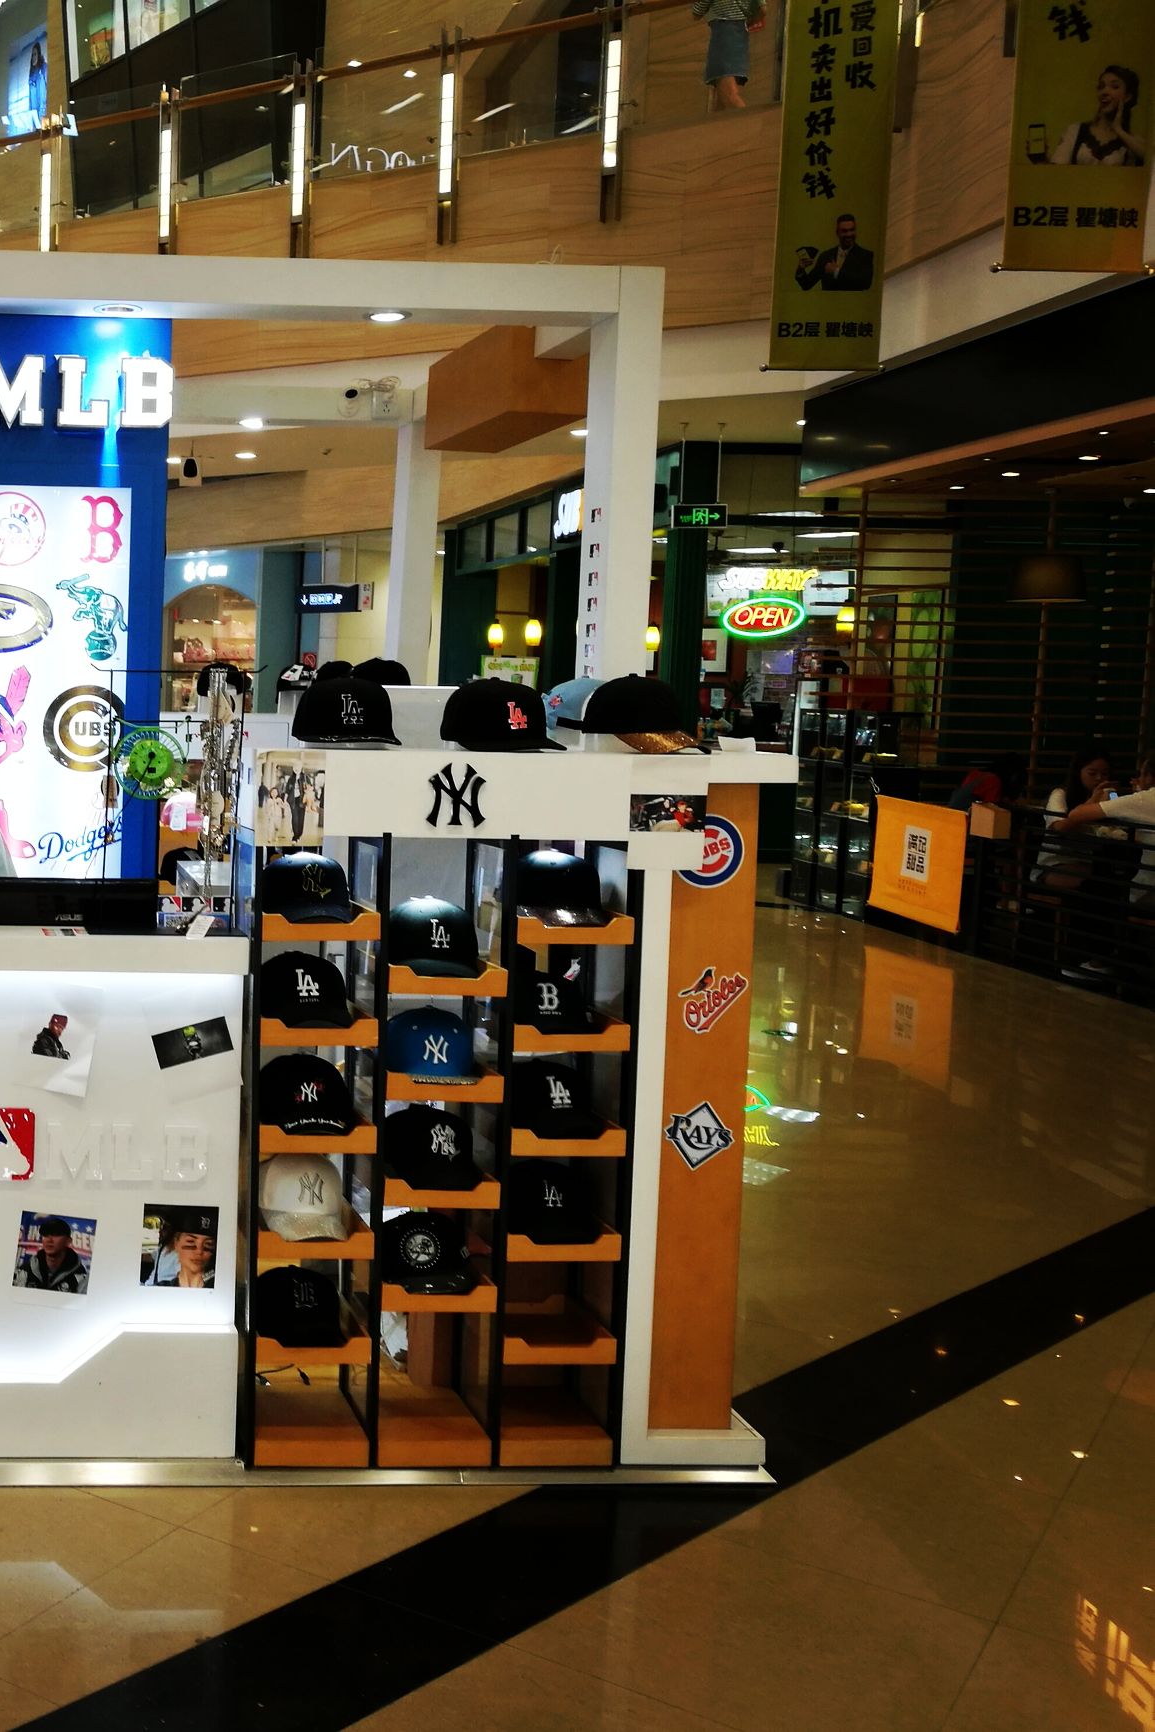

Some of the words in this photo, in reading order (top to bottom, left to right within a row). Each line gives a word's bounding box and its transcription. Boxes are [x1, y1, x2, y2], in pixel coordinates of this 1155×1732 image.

[802, 0, 843, 200] 机卖出好价钱
[1013, 206, 1068, 228] B2层
[1075, 207, 1138, 229] 瞿塘峡
[777, 322, 820, 339] B2层
[825, 321, 873, 339] 瞿塘峡
[553, 488, 584, 540] SUB
[80, 495, 123, 564] B
[717, 566, 818, 592] SUBWAY
[734, 607, 793, 627] OPEN
[342, 694, 364, 725] LA
[507, 702, 528, 730] LA
[426, 762, 487, 829] NY
[38, 815, 123, 865] Dodgers
[430, 919, 450, 948] LA
[295, 968, 320, 997] LA
[537, 983, 560, 1011] B
[684, 974, 746, 1028] Orioles
[423, 1034, 449, 1064] NY
[300, 1082, 318, 1103] NY
[546, 1076, 572, 1104] LA
[47, 1122, 209, 1181] MLB
[299, 1172, 324, 1206] NY
